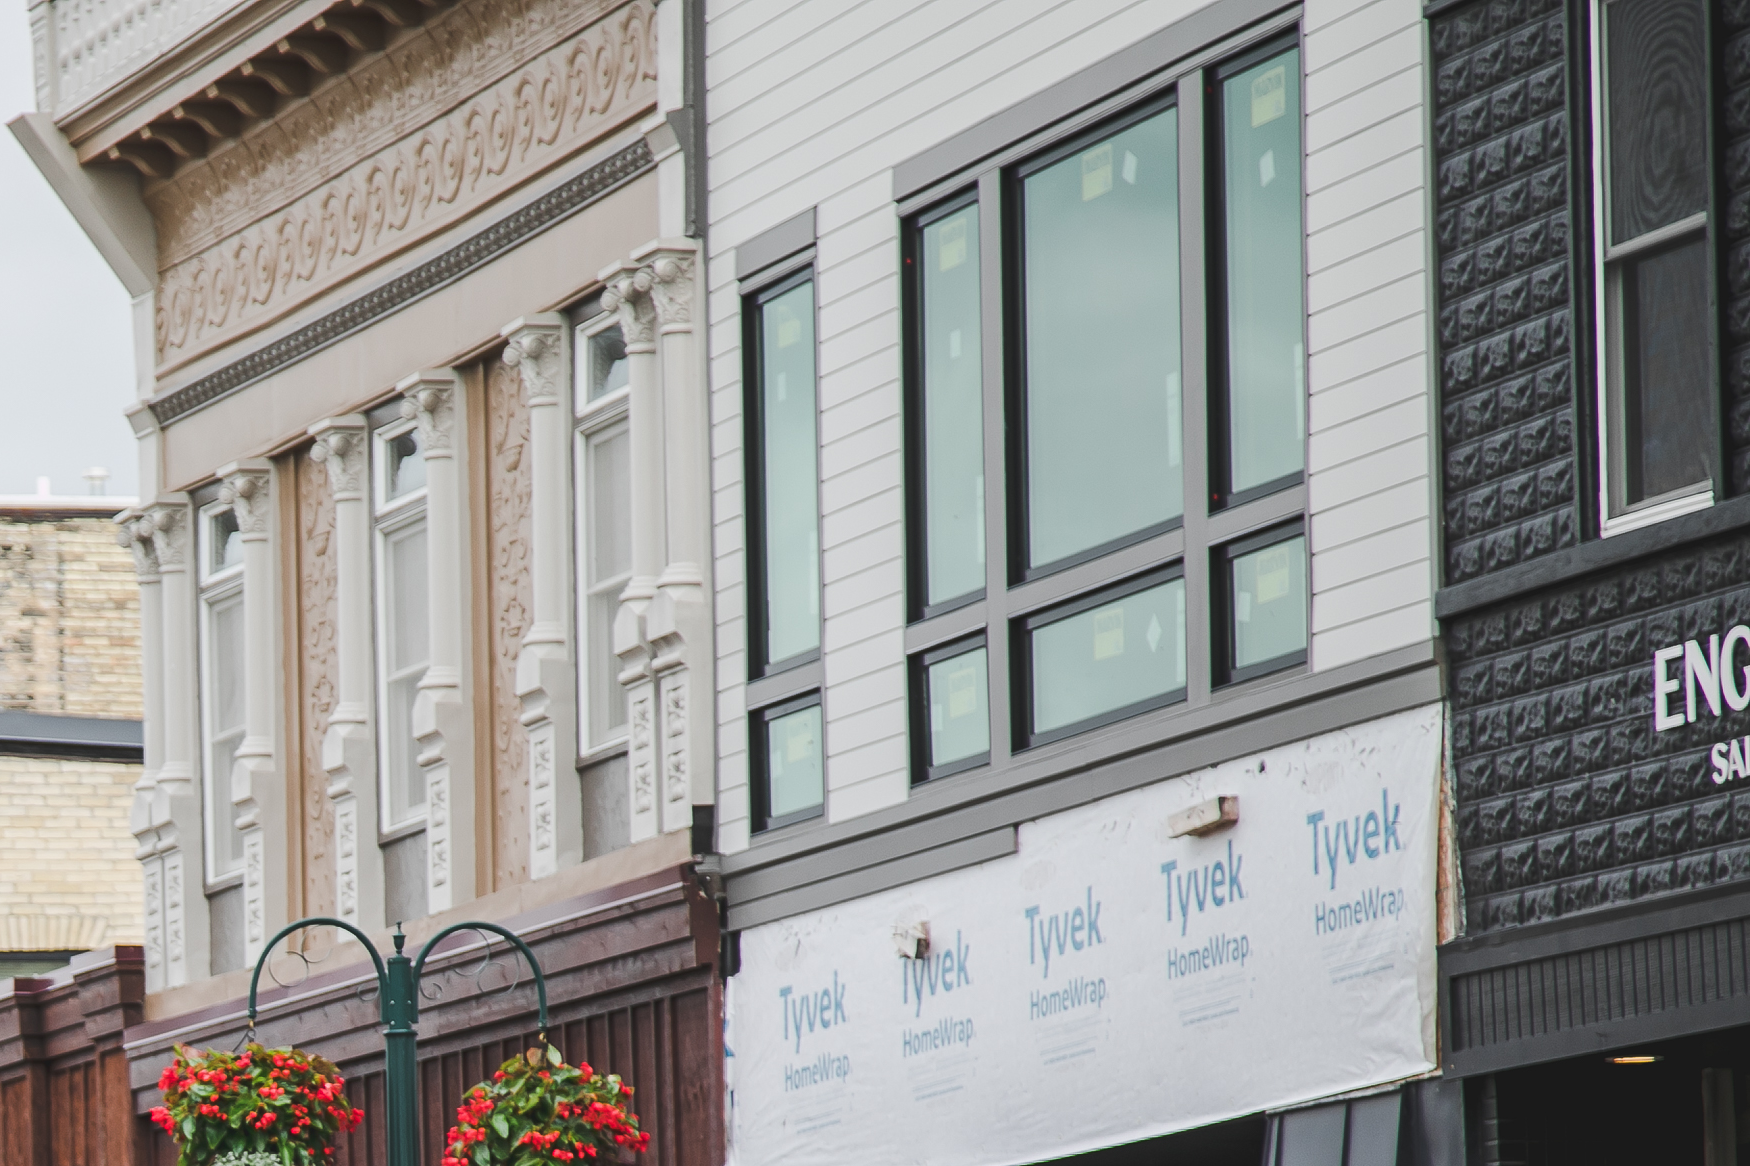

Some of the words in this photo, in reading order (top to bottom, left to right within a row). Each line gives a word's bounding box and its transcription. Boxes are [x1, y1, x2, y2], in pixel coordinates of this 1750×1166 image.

[1306, 787, 1400, 890] Tyvek
[1161, 839, 1245, 937] Tyvek
[1315, 886, 1405, 935] HomeWrap
[1025, 885, 1103, 979] Tyvek
[1168, 932, 1249, 980] HomeWrap
[901, 929, 970, 1018] Tyvek
[1030, 976, 1106, 1021] HomeWrap
[779, 969, 847, 1053] Tyvek
[903, 1016, 974, 1058] HomeWrap
[784, 1053, 850, 1092] HomeWrap
